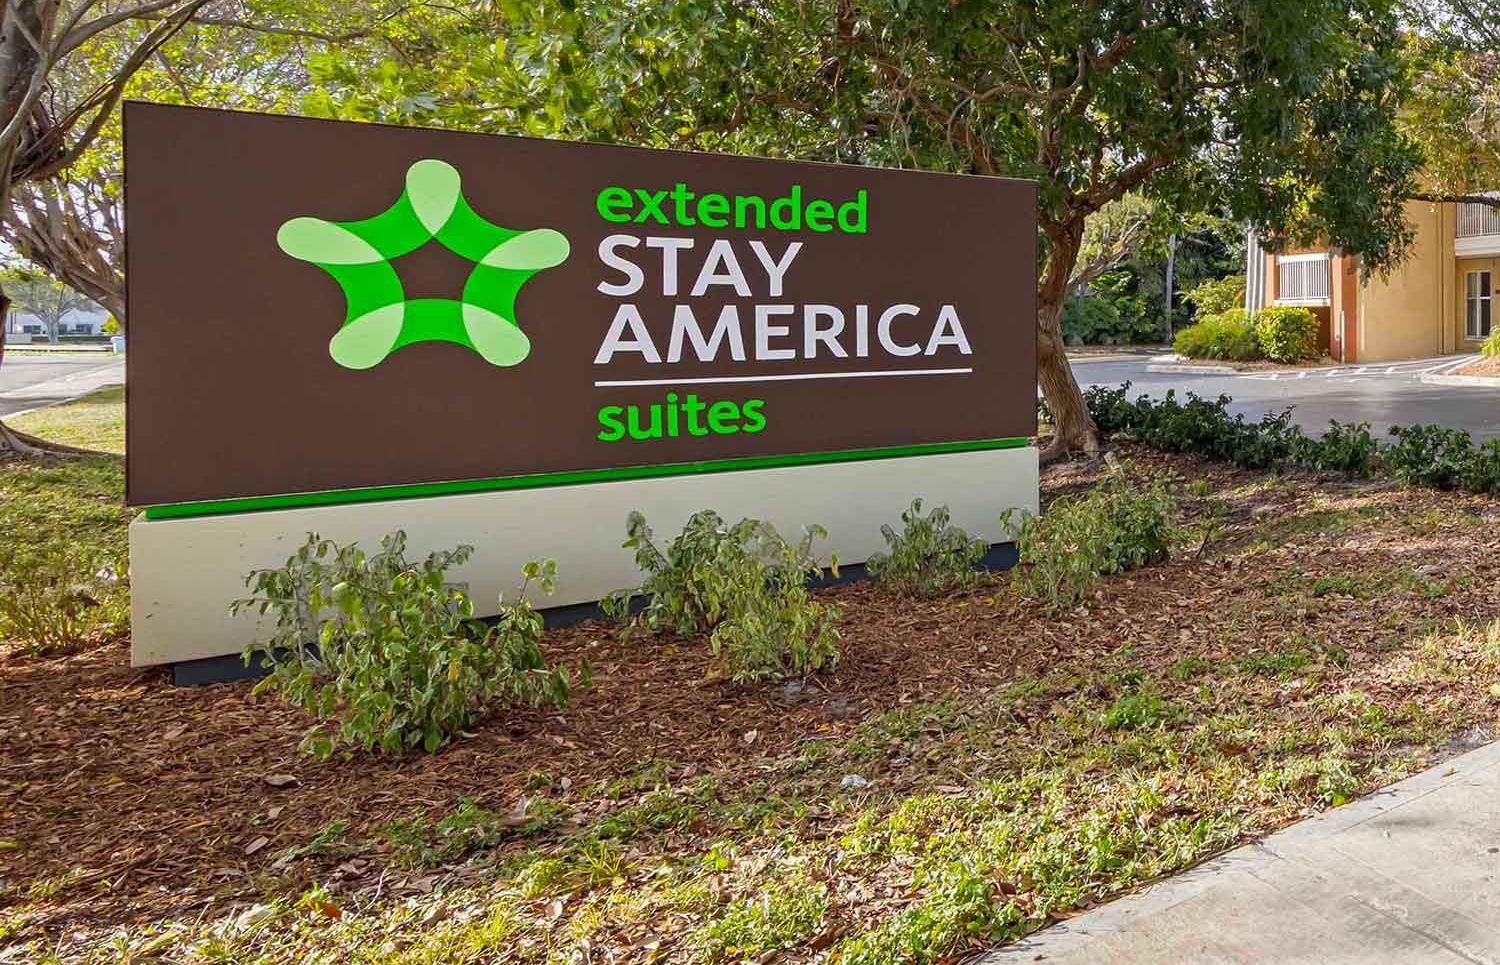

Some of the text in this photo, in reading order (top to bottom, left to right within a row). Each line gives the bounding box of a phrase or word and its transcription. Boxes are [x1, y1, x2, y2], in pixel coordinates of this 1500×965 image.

[596, 182, 867, 234] extended
[597, 235, 803, 296] STAY
[594, 304, 972, 363] AMERICA
[597, 392, 766, 441] suites
